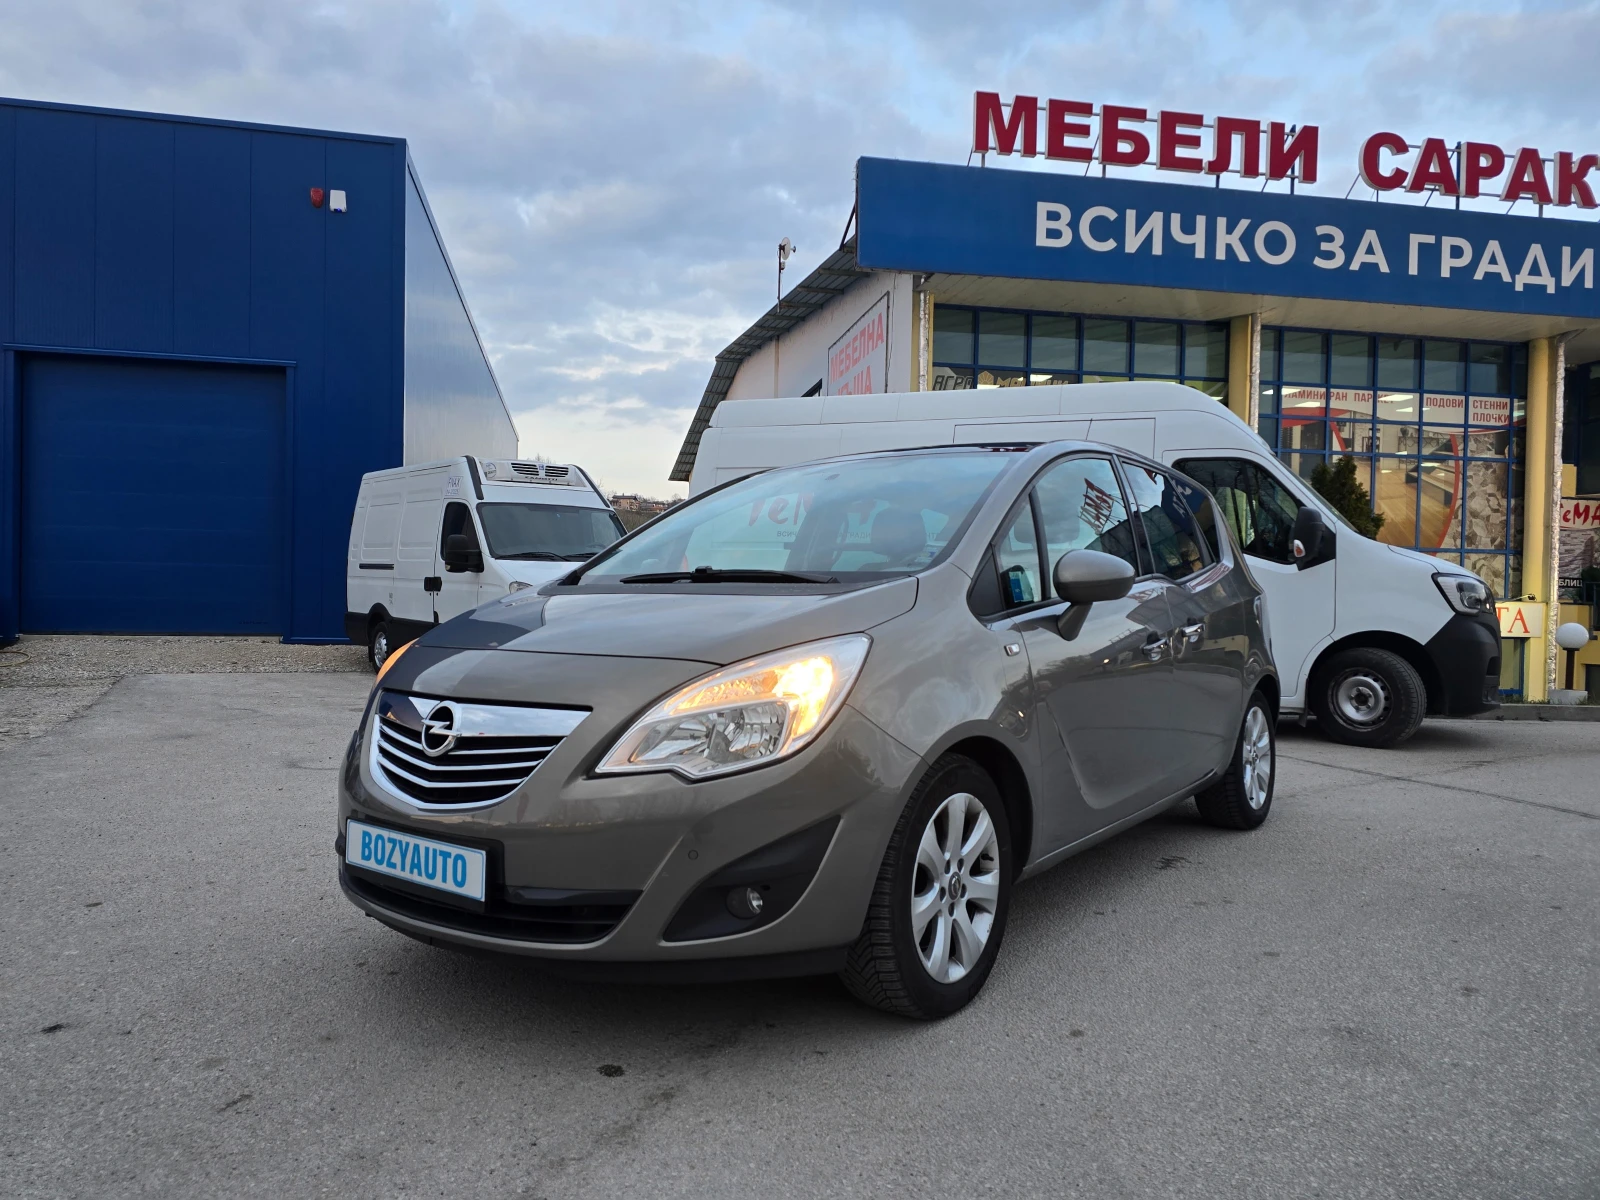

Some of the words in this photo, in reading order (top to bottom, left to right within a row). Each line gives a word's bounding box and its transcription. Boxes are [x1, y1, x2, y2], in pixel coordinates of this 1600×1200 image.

[973, 90, 1319, 184] МЕБЕЛИ
[1035, 201, 1297, 266] ВСИЧКО
[1313, 224, 1390, 274] ЗА
[1408, 233, 1594, 294] ГРАДИ
[830, 311, 884, 385] МЕБЕЛНА
[1425, 396, 1464, 409] ПОДОВИ
[1472, 399, 1508, 410] СТЕННИ
[1472, 412, 1511, 424] ПЛОЧКИ
[361, 829, 467, 889] BOZYAUTO
